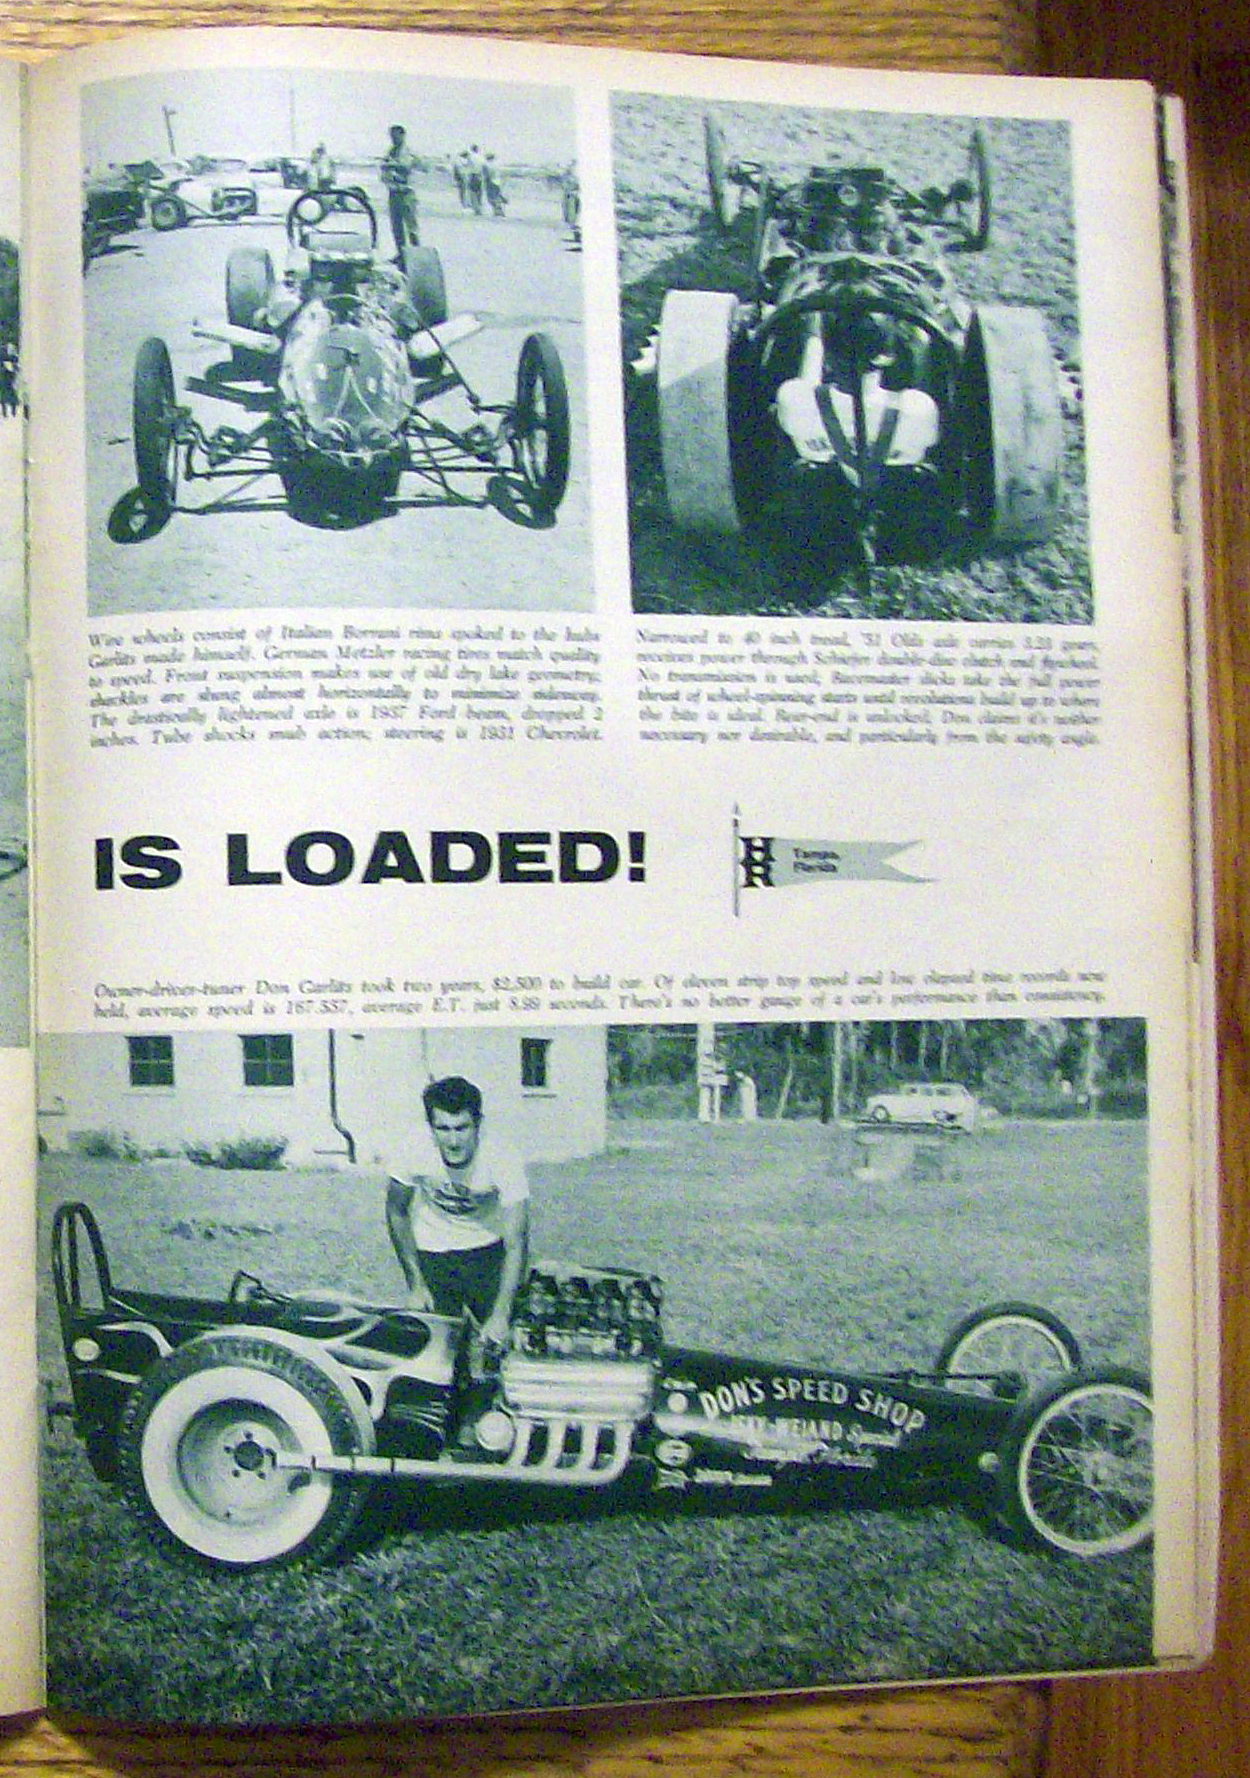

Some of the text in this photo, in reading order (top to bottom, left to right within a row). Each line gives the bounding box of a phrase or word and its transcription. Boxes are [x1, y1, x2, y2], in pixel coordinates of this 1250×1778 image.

[95, 831, 647, 890] IS LOADED!
[772, 1377, 849, 1405] SPEED
[855, 1390, 926, 1434] SHOP
